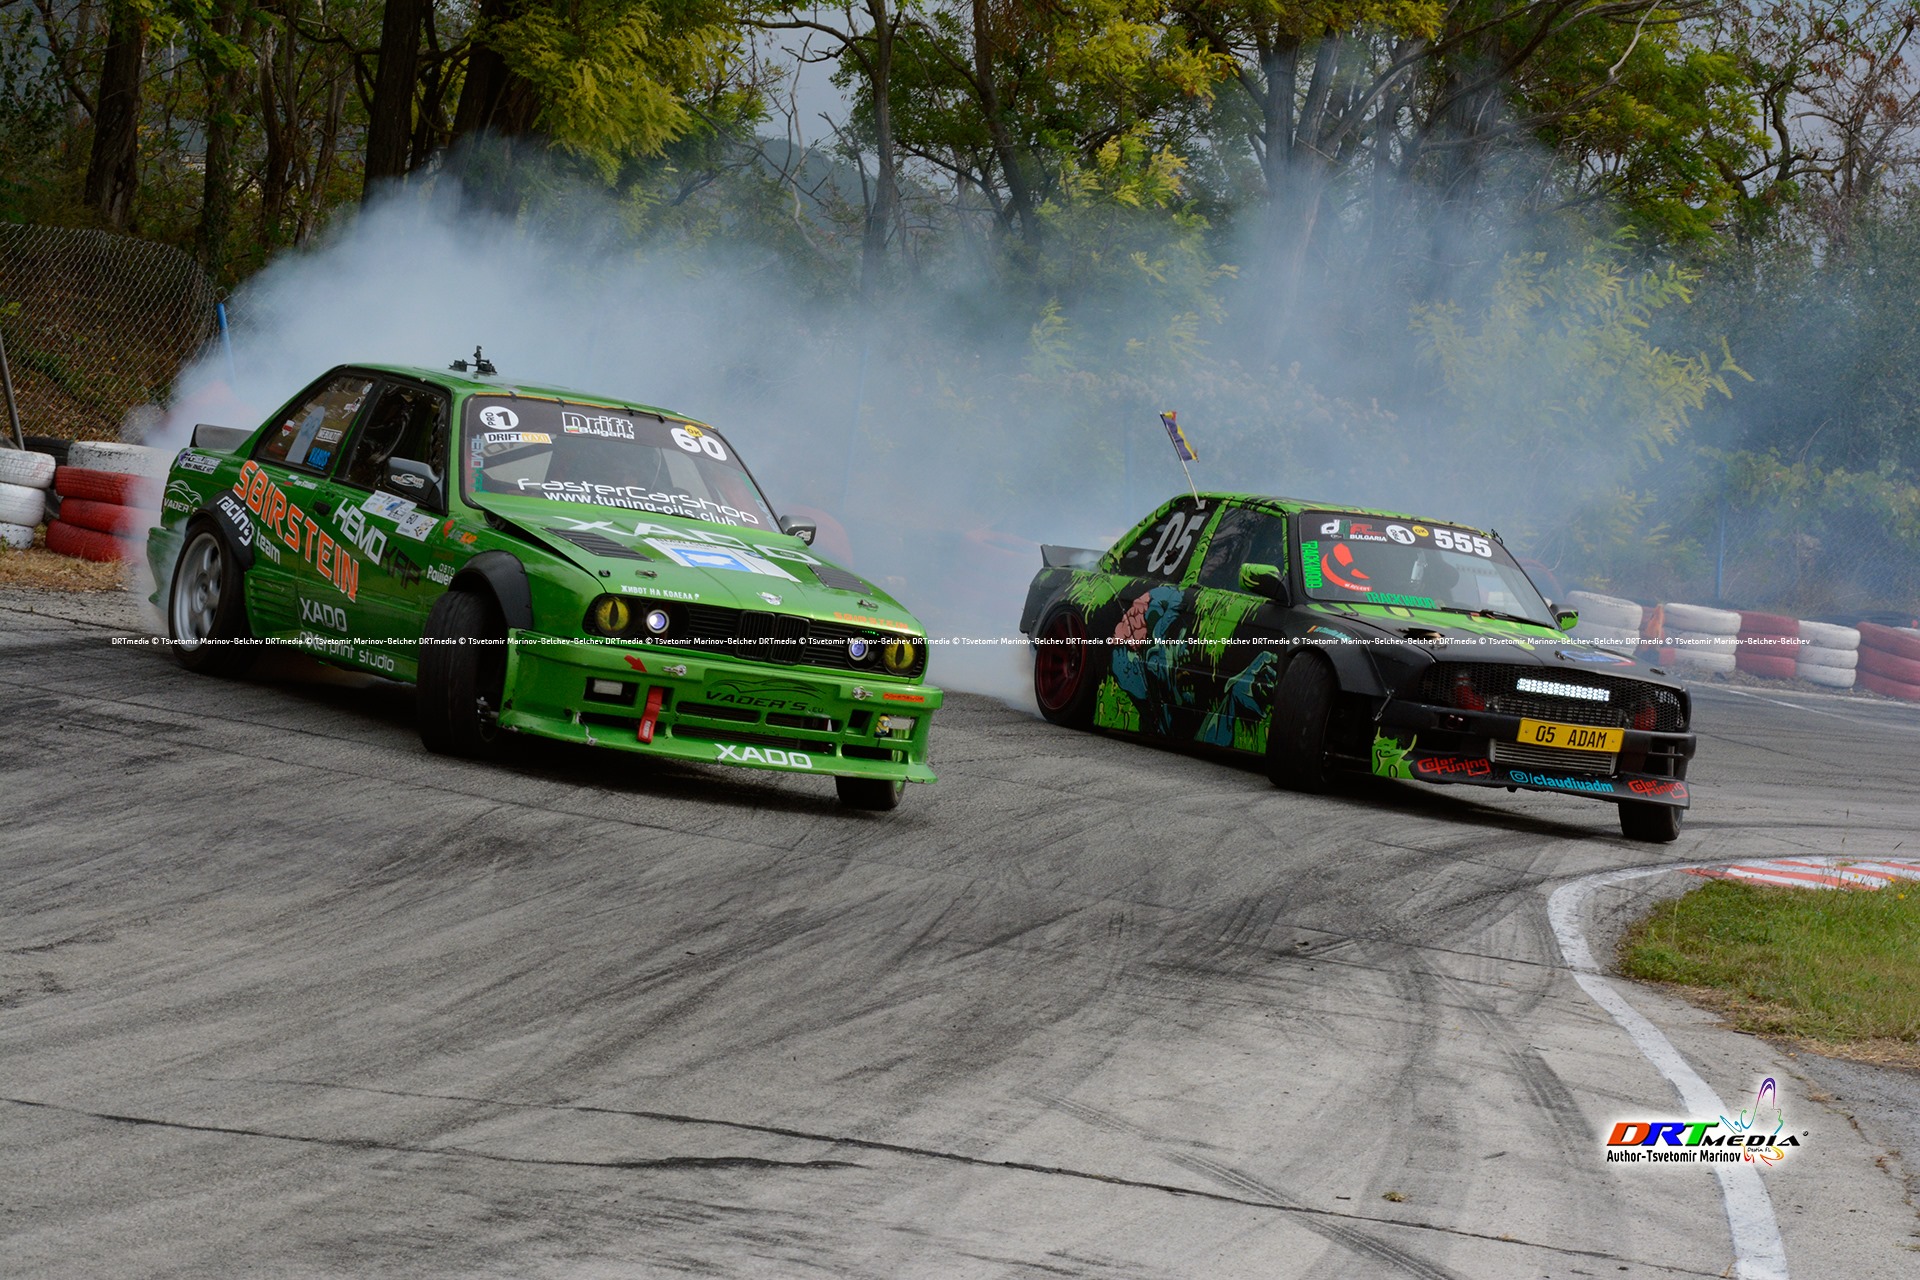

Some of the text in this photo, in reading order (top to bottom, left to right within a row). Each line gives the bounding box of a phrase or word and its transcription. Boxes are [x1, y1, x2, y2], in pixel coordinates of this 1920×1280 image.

[485, 411, 496, 426] PRO
[496, 411, 512, 427] 1
[561, 411, 635, 435] Drift
[488, 433, 521, 442] DRIFT
[578, 426, 635, 440] Bulgaria
[670, 427, 727, 461] 60
[517, 478, 759, 525] FasterCarShop
[216, 495, 281, 566] racing team
[232, 459, 359, 604] SBIRSTEIN
[1349, 533, 1387, 542] BULGARIA
[1398, 529, 1412, 542] 1
[1147, 511, 1206, 576] 05
[1433, 528, 1493, 558] 555
[620, 585, 647, 595] ЖИВОТ
[649, 587, 661, 597] НА
[300, 597, 347, 633] XADO
[359, 648, 394, 672] studio
[1535, 725, 1608, 749] 05 ADAM
[714, 743, 813, 769] XADO
